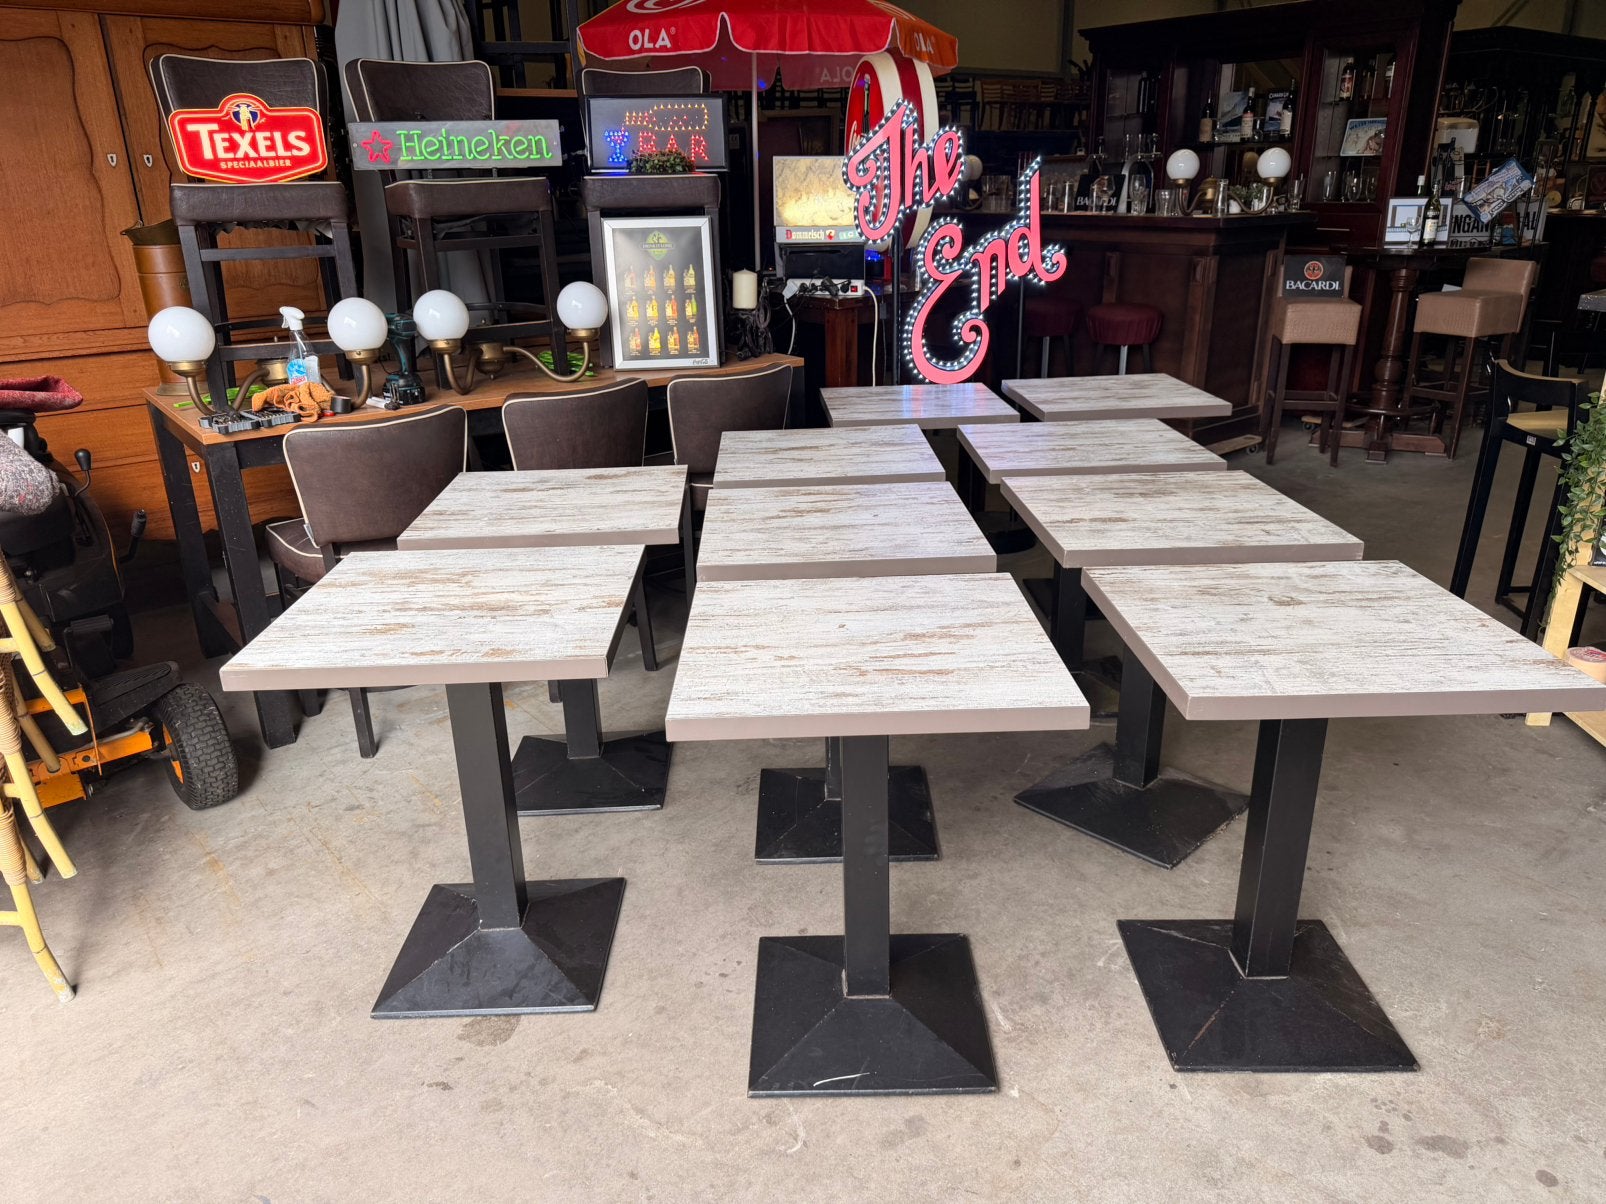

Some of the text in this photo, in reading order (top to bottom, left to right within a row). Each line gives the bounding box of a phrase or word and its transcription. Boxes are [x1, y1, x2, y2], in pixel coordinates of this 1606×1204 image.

[186, 123, 311, 160] TEXELS
[396, 129, 553, 161] Heineken
[638, 130, 709, 162] BAR
[219, 159, 293, 170] SPECIAALBIER
[844, 100, 965, 243] The
[905, 156, 1068, 384] End
[1285, 280, 1340, 291] BACARDI
